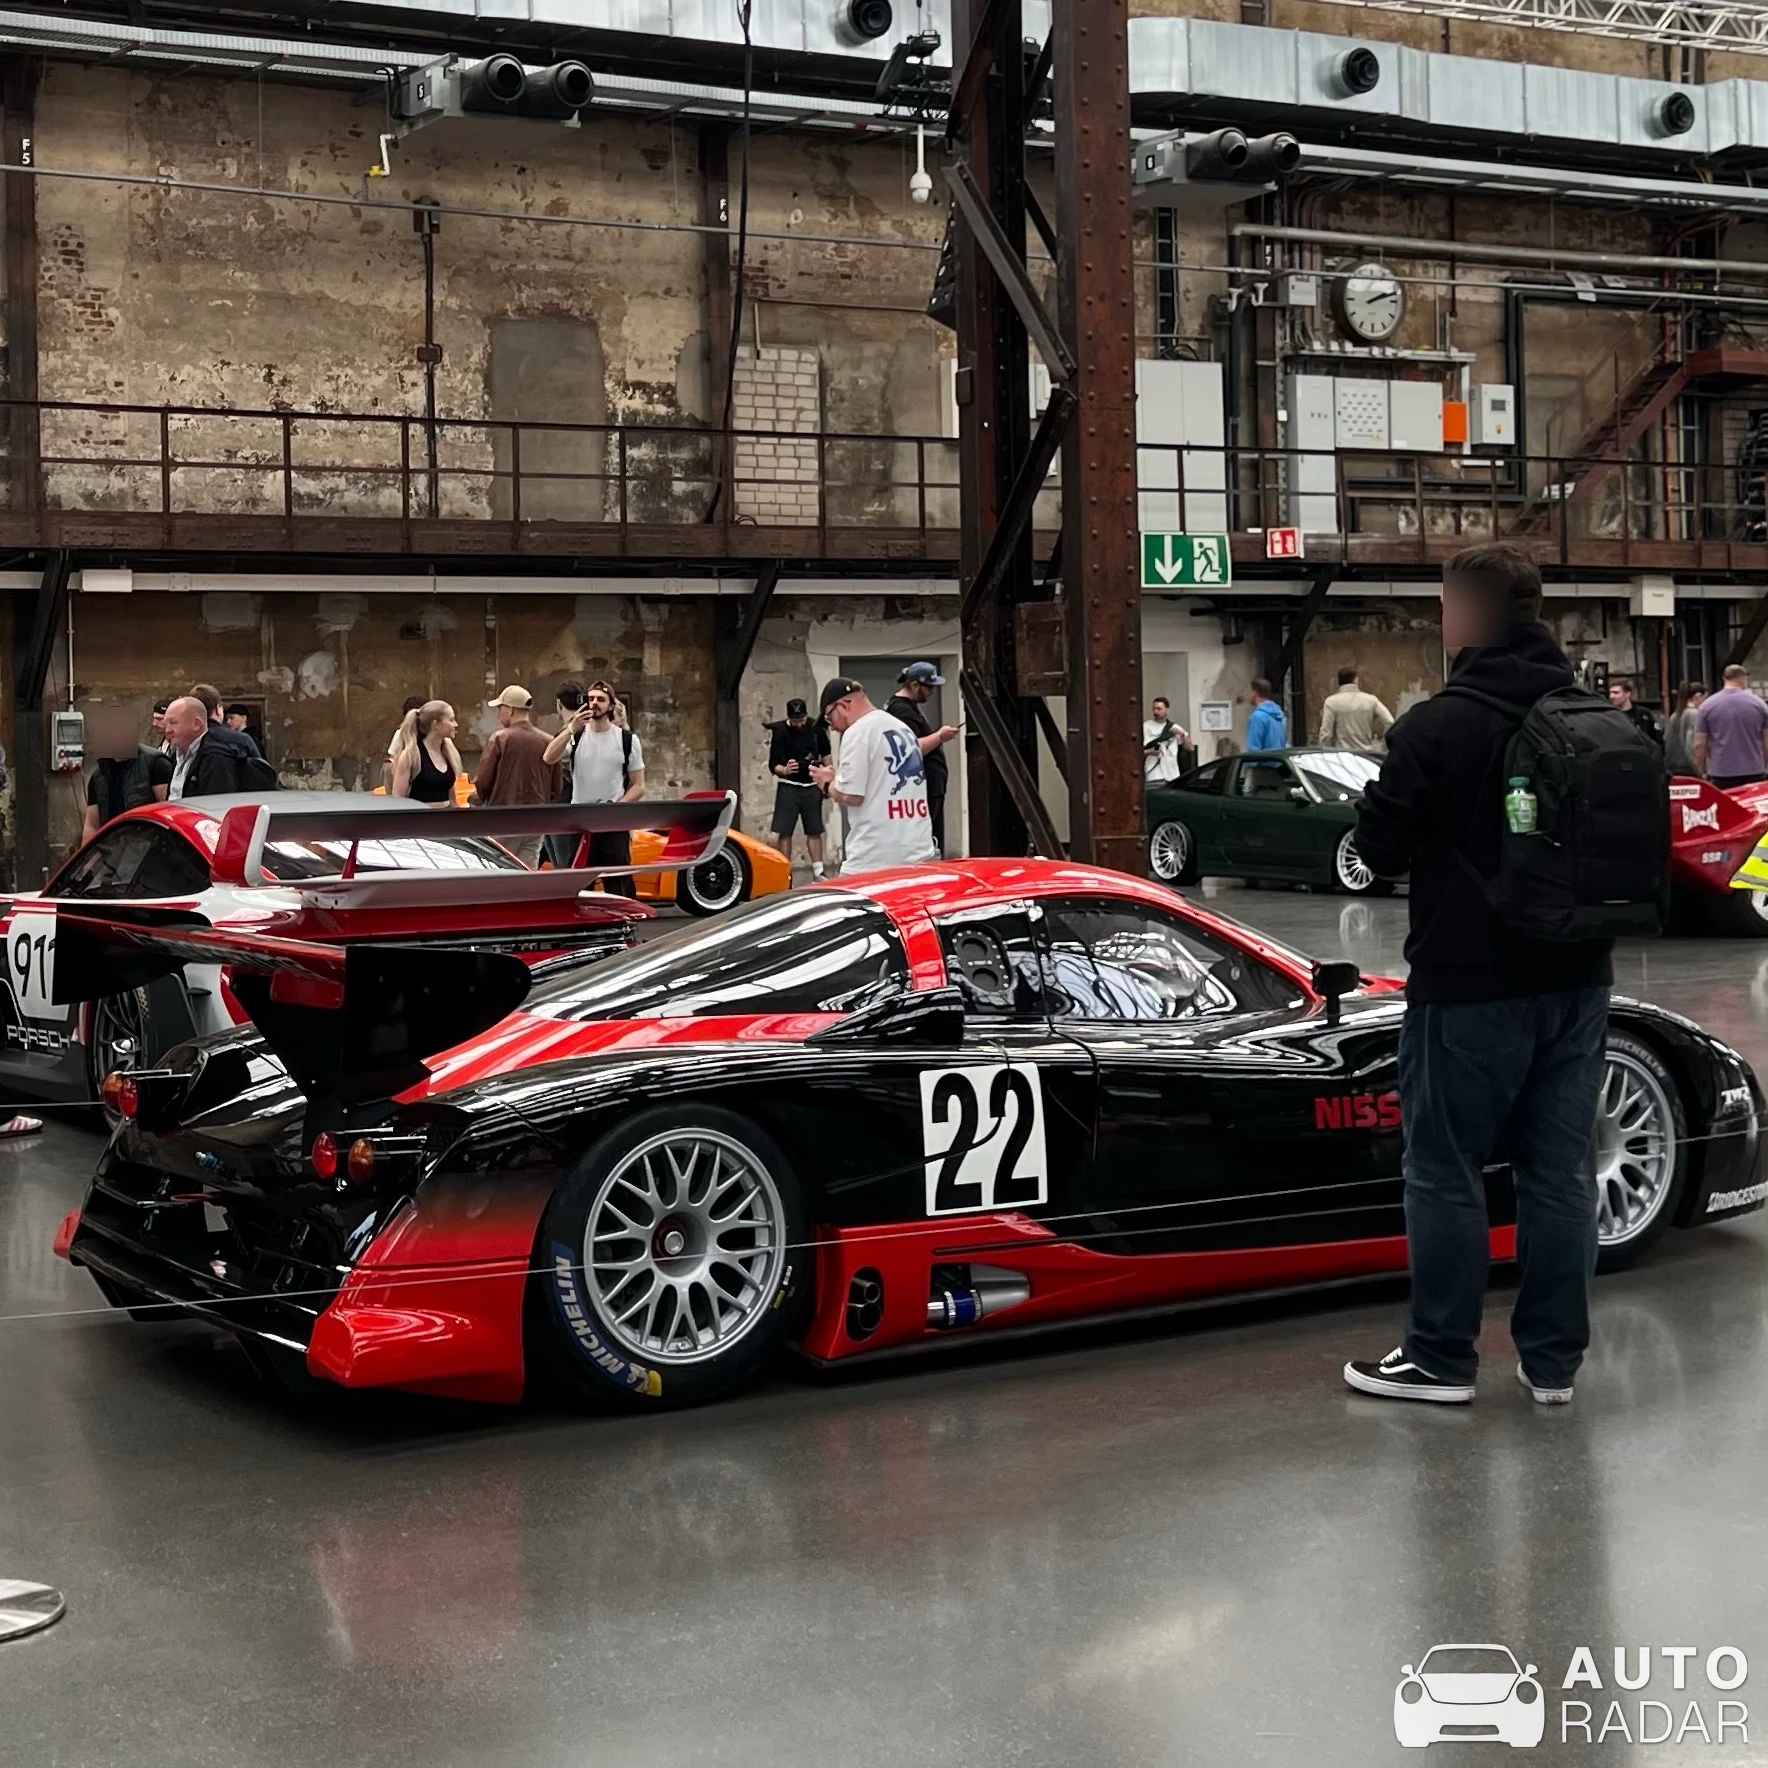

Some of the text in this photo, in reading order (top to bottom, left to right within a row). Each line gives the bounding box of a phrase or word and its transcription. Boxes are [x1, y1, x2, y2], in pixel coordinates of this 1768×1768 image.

[888, 798, 928, 820] HUG
[14, 932, 56, 1000] 91
[931, 1067, 1040, 1211] 22
[1314, 1093, 1402, 1130] NISS
[555, 1255, 625, 1375] MICHELIN
